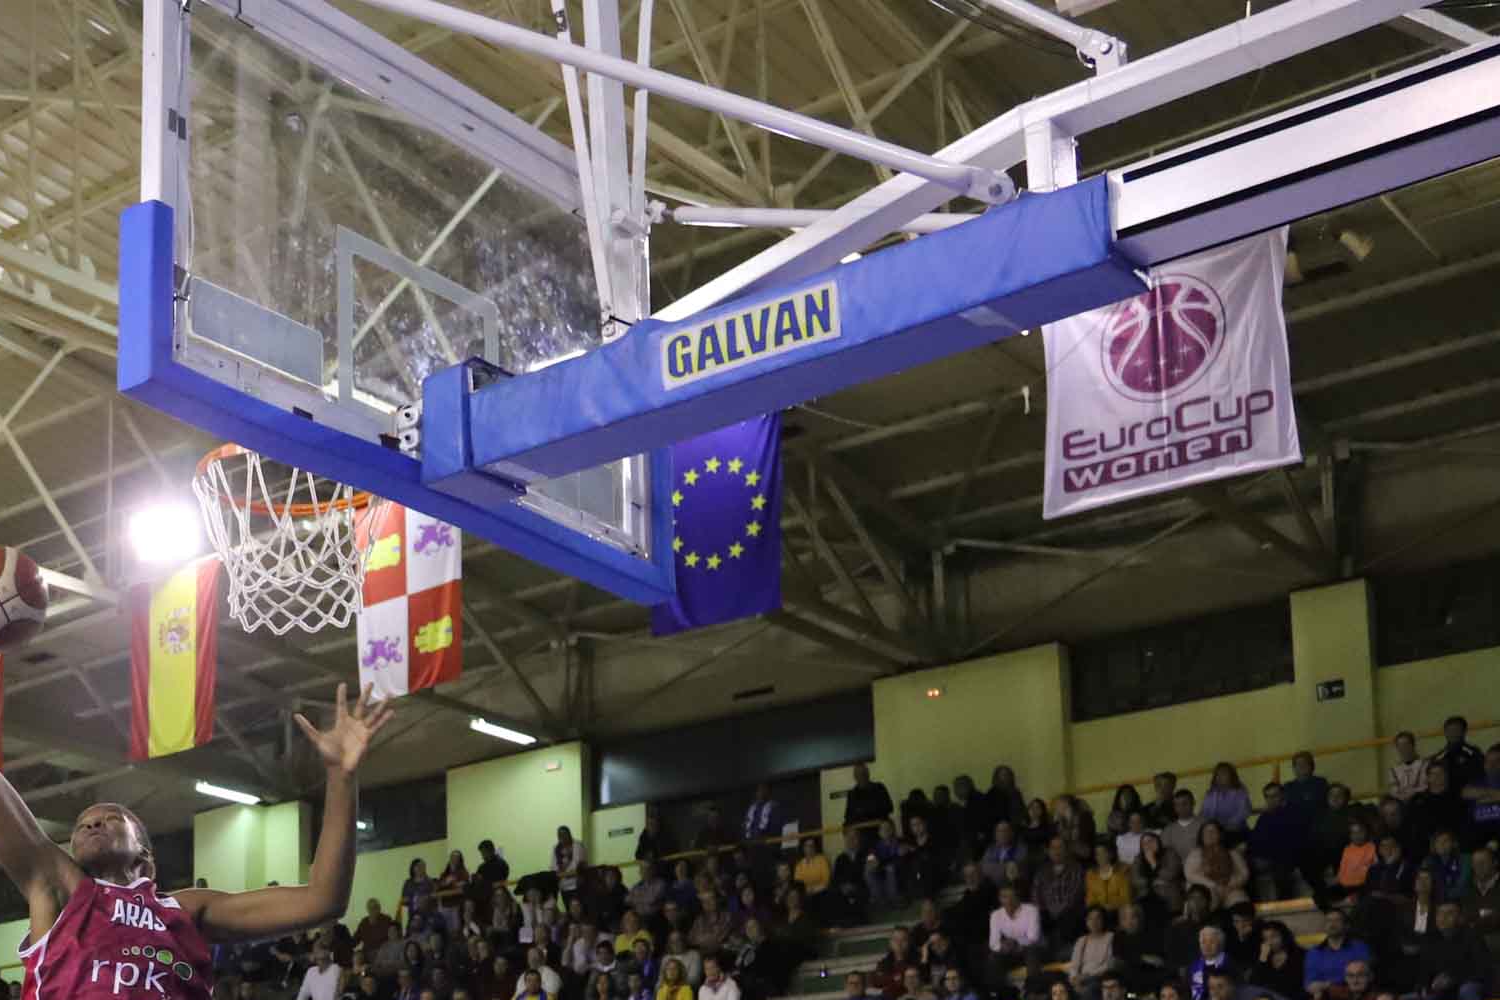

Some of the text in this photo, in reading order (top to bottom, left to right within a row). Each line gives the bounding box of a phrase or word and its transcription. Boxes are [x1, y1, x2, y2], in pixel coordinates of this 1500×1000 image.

[667, 288, 831, 378] GALVAN
[1062, 389, 1274, 460] EuroCup
[1067, 430, 1250, 489] women
[91, 959, 169, 994] rpk
